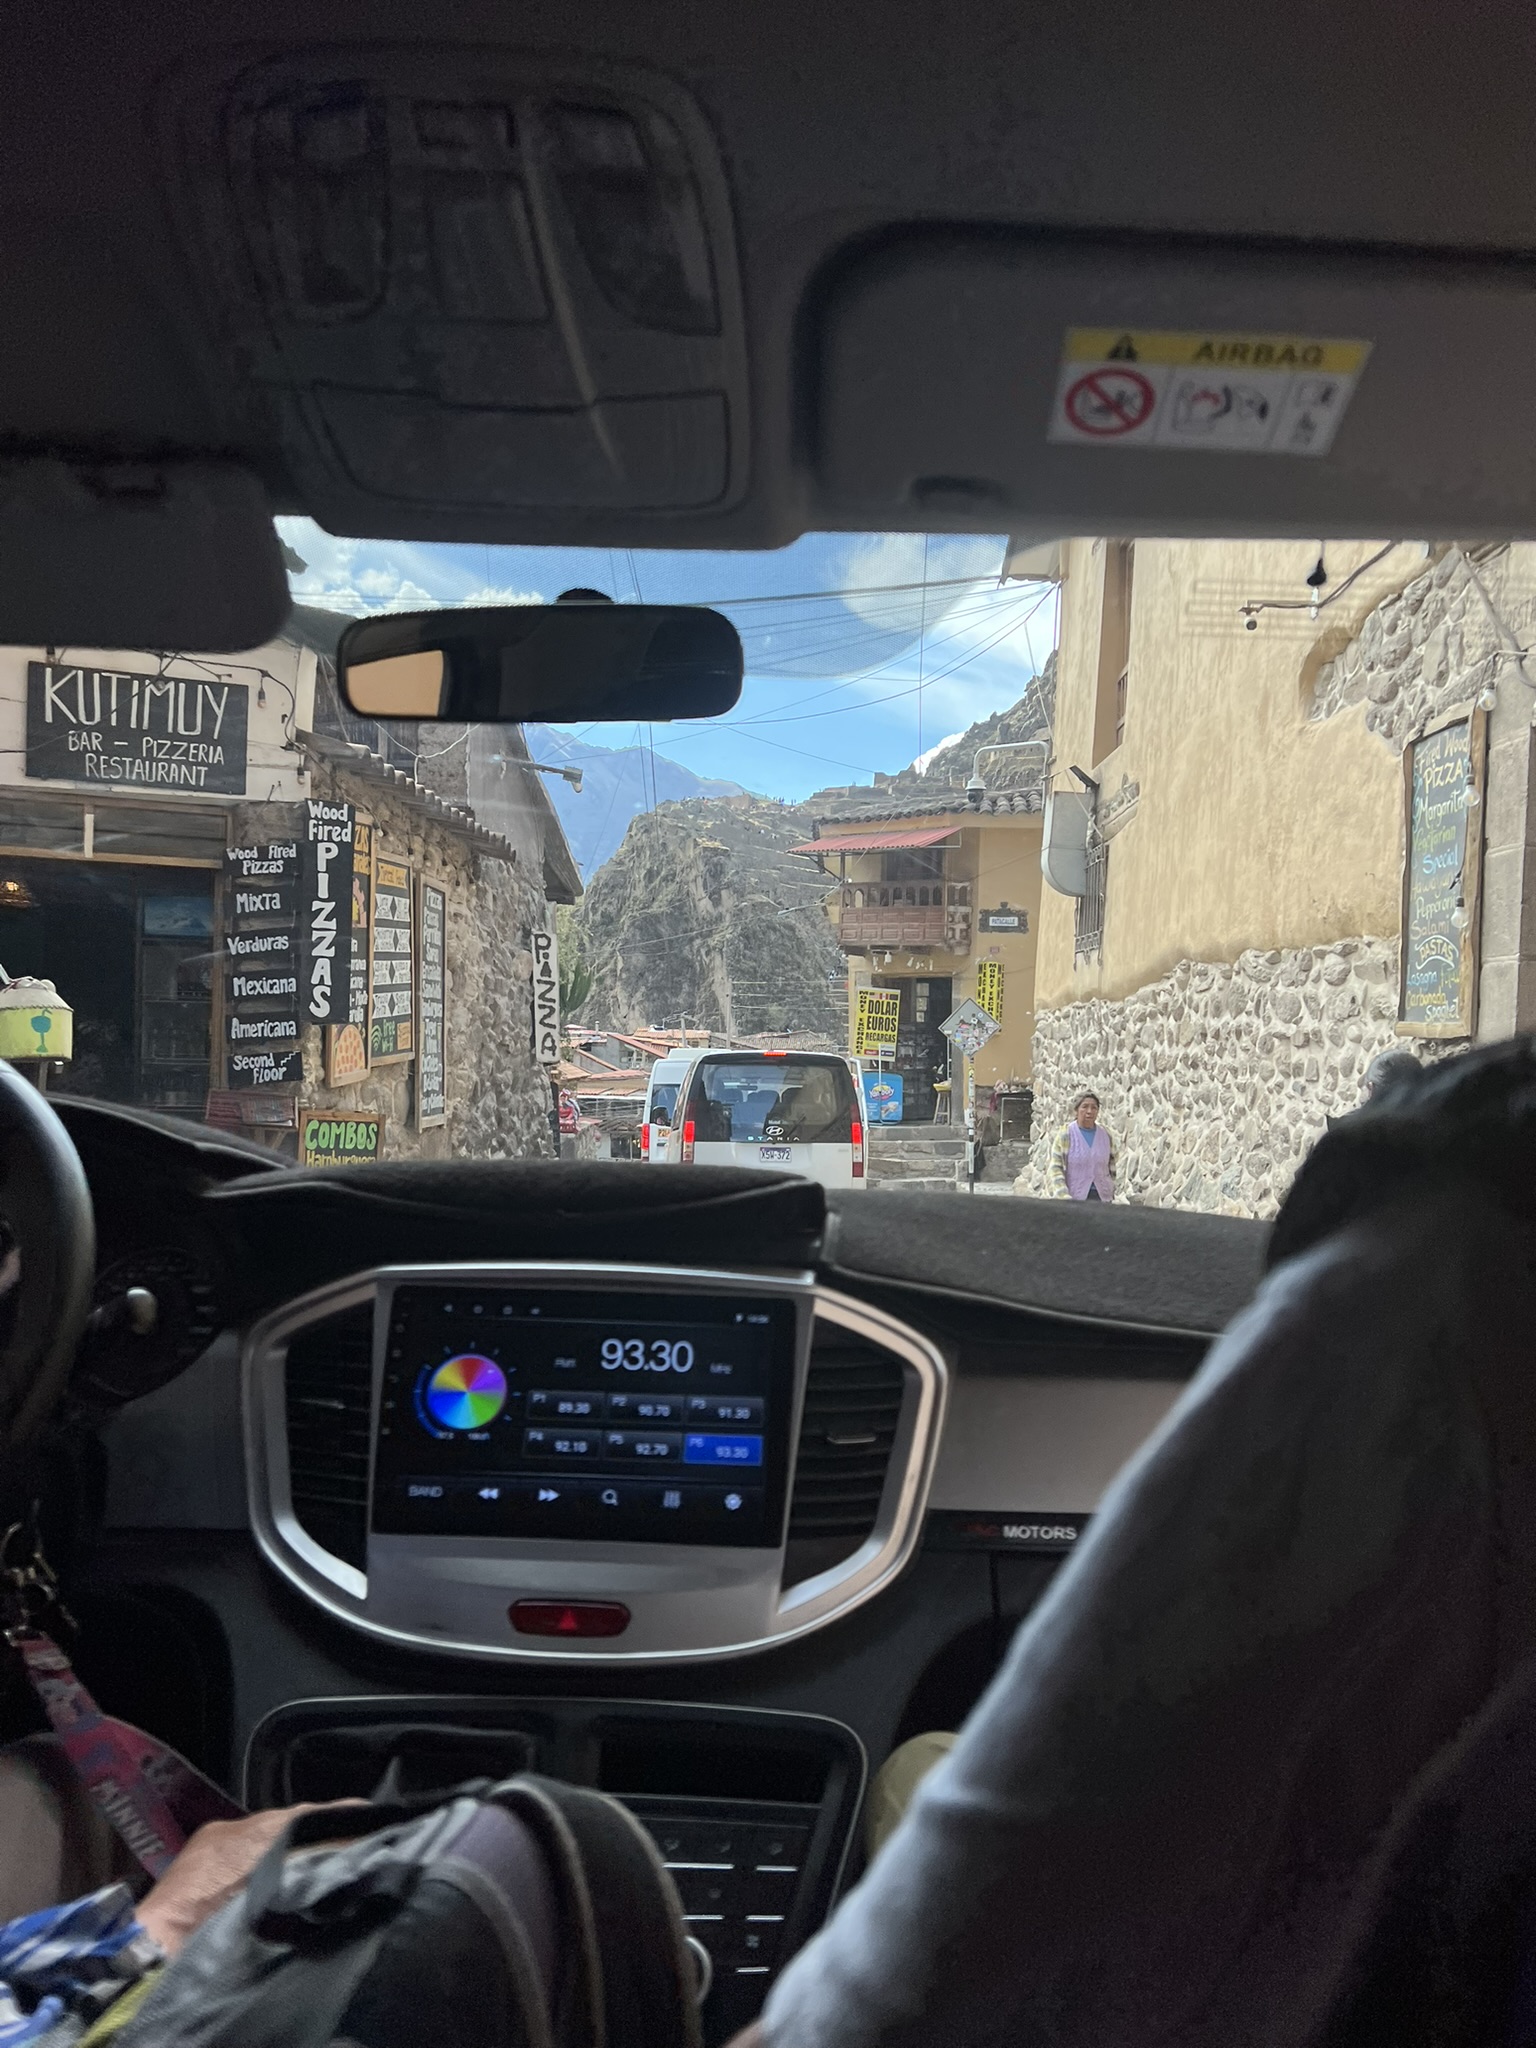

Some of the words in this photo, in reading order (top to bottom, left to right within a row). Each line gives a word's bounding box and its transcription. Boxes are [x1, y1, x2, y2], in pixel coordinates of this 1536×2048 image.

[68, 730, 103, 751] BAR
[142, 736, 224, 766] PIZZERIA
[85, 753, 208, 786] RESTAURANT
[307, 800, 348, 822] Wood
[226, 846, 258, 860] Wood
[1423, 843, 1458, 875] Special
[242, 860, 284, 875] Pizzas
[308, 842, 339, 1018] PIZZAS
[1410, 914, 1450, 940] Salami
[227, 935, 289, 955] Verduras
[1420, 939, 1453, 962] PASTAS
[233, 976, 297, 996] Mexicana
[988, 963, 997, 989] MONEY
[859, 990, 869, 1013] MONEY
[867, 999, 898, 1017] DOLAR
[231, 1017, 297, 1039] Americana
[866, 1015, 897, 1033] EUROS
[855, 1017, 865, 1054] EXCHANGE
[865, 1031, 896, 1043] RECARGAS
[233, 1053, 275, 1071] Second
[305, 1120, 378, 1150] COMBOS
[601, 1338, 694, 1373] 93.30
[1003, 1524, 1078, 1540] MOTORS
